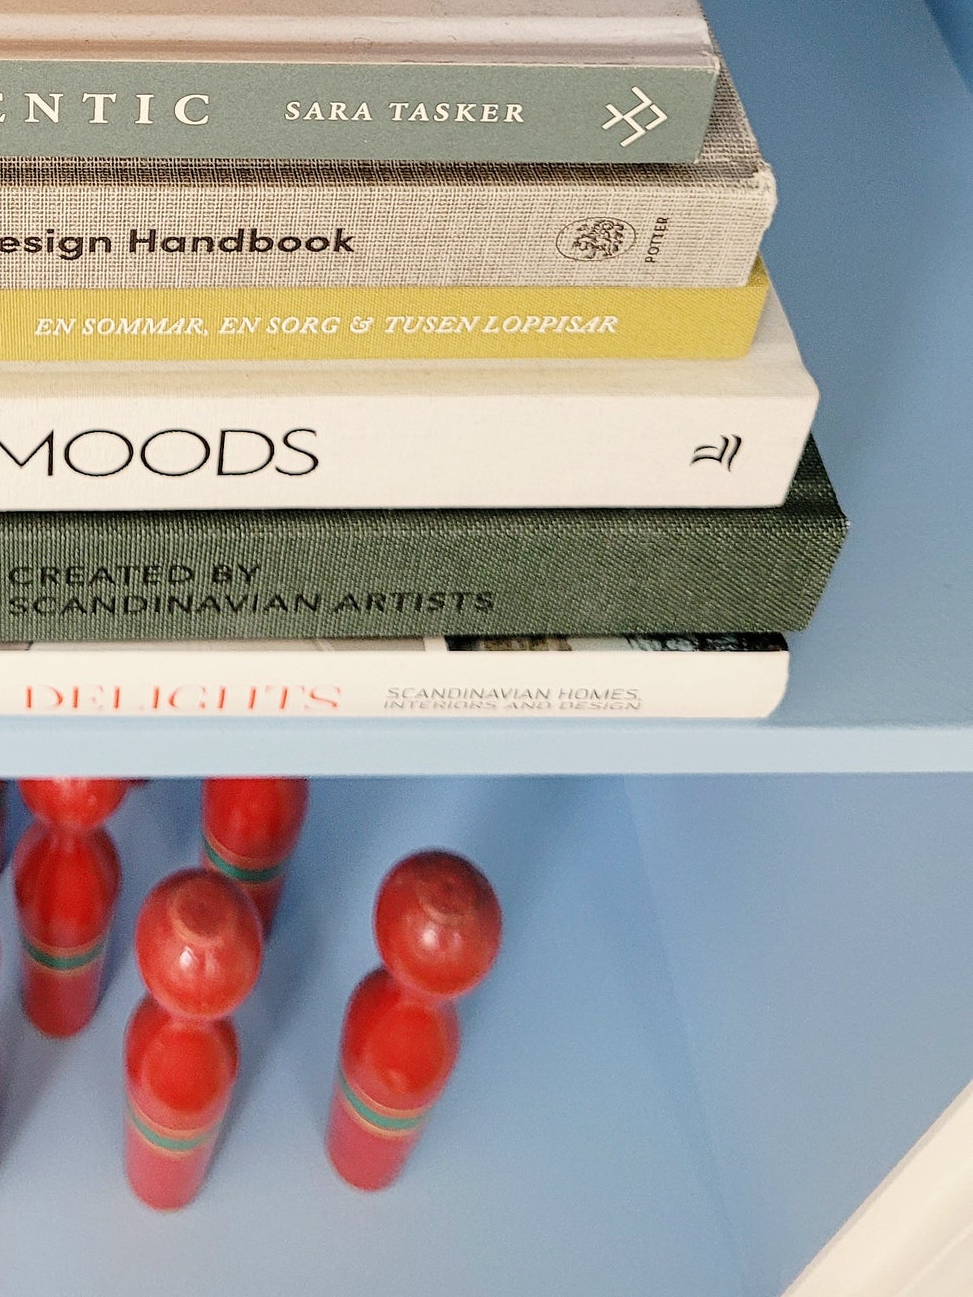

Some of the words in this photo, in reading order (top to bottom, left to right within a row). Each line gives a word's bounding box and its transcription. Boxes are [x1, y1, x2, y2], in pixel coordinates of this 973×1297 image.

[284, 101, 373, 122] SARA
[389, 102, 525, 124] TASKER
[129, 228, 355, 254] Handbook
[644, 216, 669, 264] POTTER
[34, 317, 76, 336] EN
[81, 316, 209, 337] SOMMAR,
[218, 316, 261, 335] EN
[265, 316, 341, 335] SORG
[349, 315, 374, 334] &
[384, 315, 480, 334] TUSEN
[482, 315, 619, 334] LOPPISAR
[9, 564, 194, 586] CREATED
[213, 563, 262, 585] BY
[9, 595, 320, 615] SCANDINAVIAN
[334, 592, 494, 613] ARTISTS
[25, 684, 343, 711] DELIGHTS
[386, 686, 551, 700] SCANDINAVIAN
[558, 687, 642, 701] HOMES,
[383, 700, 497, 711] INTERIORS
[505, 700, 552, 711] AND
[558, 700, 642, 711] DESIGN
